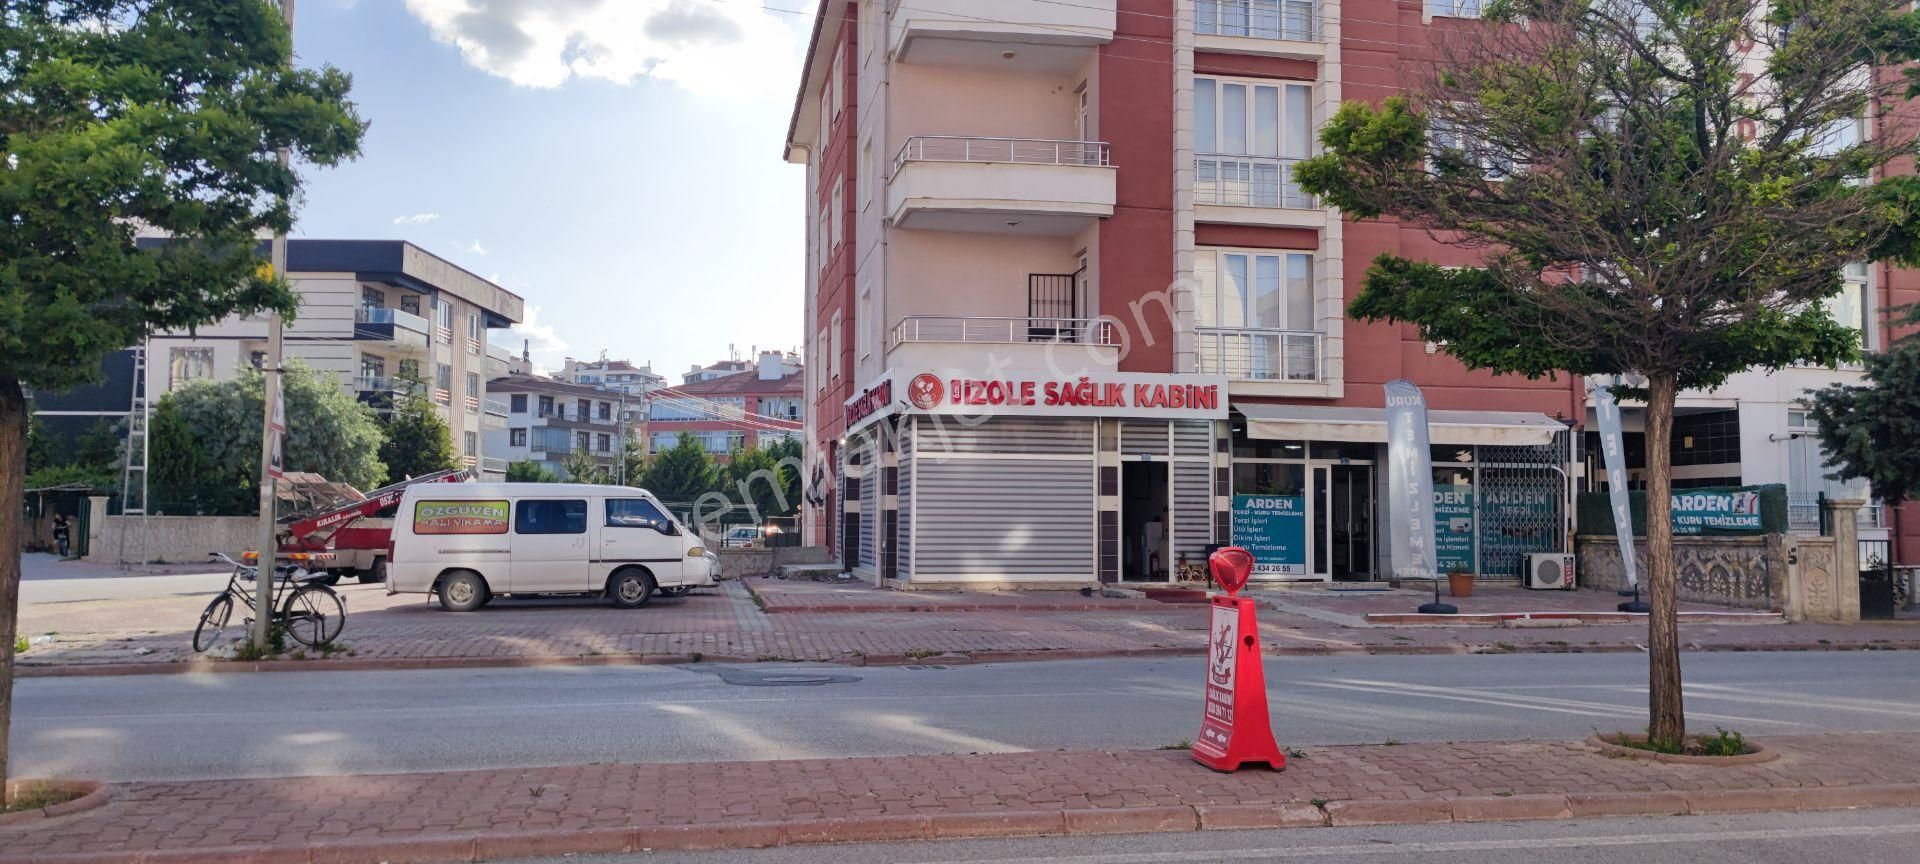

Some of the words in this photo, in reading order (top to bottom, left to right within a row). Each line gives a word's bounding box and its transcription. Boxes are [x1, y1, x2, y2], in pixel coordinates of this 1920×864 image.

[964, 380, 1036, 406] İZOLE
[1044, 376, 1126, 408] SAĞLIK
[1246, 498, 1293, 509] ARDEN
[1433, 492, 1465, 504] DEN
[1671, 495, 1730, 511] ARDEN
[420, 505, 504, 517] ÖZGÜVEN
[1435, 505, 1470, 513] MİZLEME
[453, 519, 503, 527] YIKAMA
[1251, 517, 1268, 525] İşleri
[1677, 516, 1702, 525] KURU
[1704, 514, 1760, 526] TEMİZLEME
[1247, 525, 1264, 533] İşleri
[1254, 533, 1271, 542] İşleri
